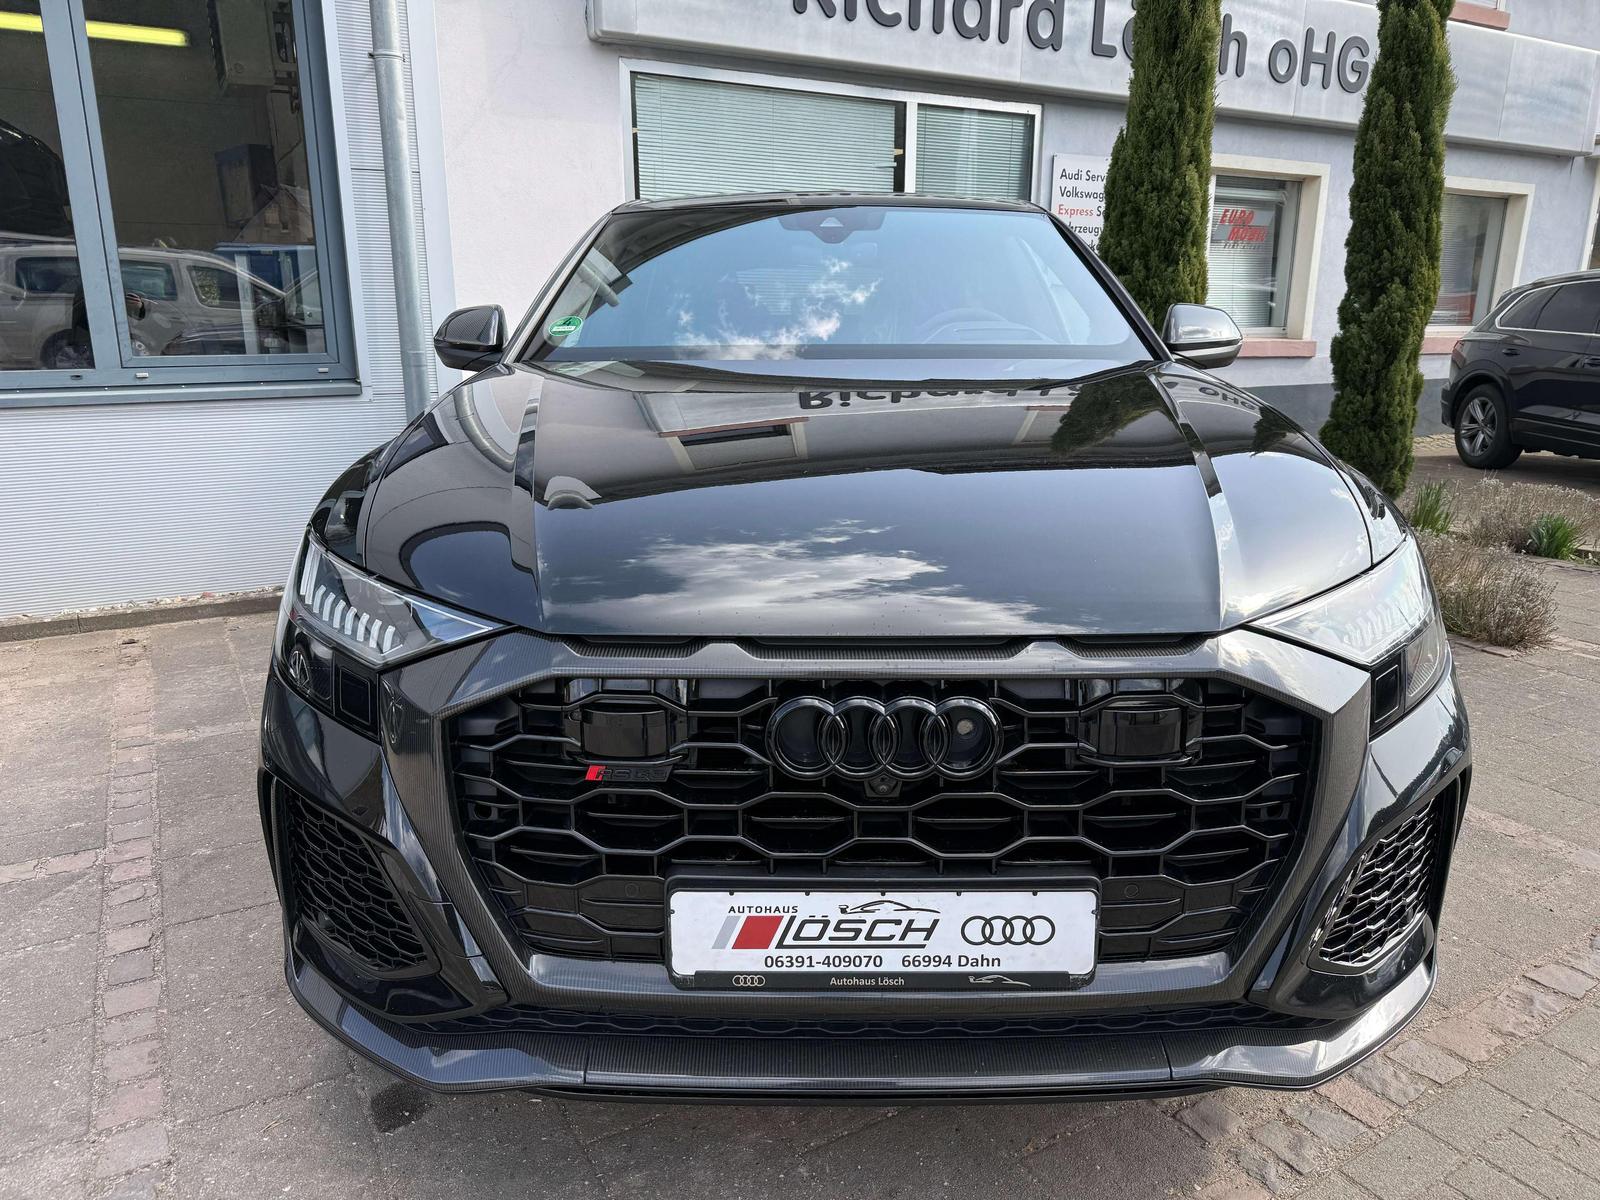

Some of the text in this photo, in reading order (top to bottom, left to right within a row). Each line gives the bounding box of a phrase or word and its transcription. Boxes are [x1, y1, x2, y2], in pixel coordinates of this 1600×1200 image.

[1268, 27, 1370, 94] oHG
[1059, 168, 1083, 181] Audi
[1058, 204, 1094, 218] Express
[1219, 207, 1255, 225] EURO
[728, 905, 799, 914] AUTOHAUS
[775, 915, 941, 950] LÖSCH
[764, 954, 1001, 968] 06391-409070 66994 Dahn
[830, 975, 905, 986] Autohaus Lösch
